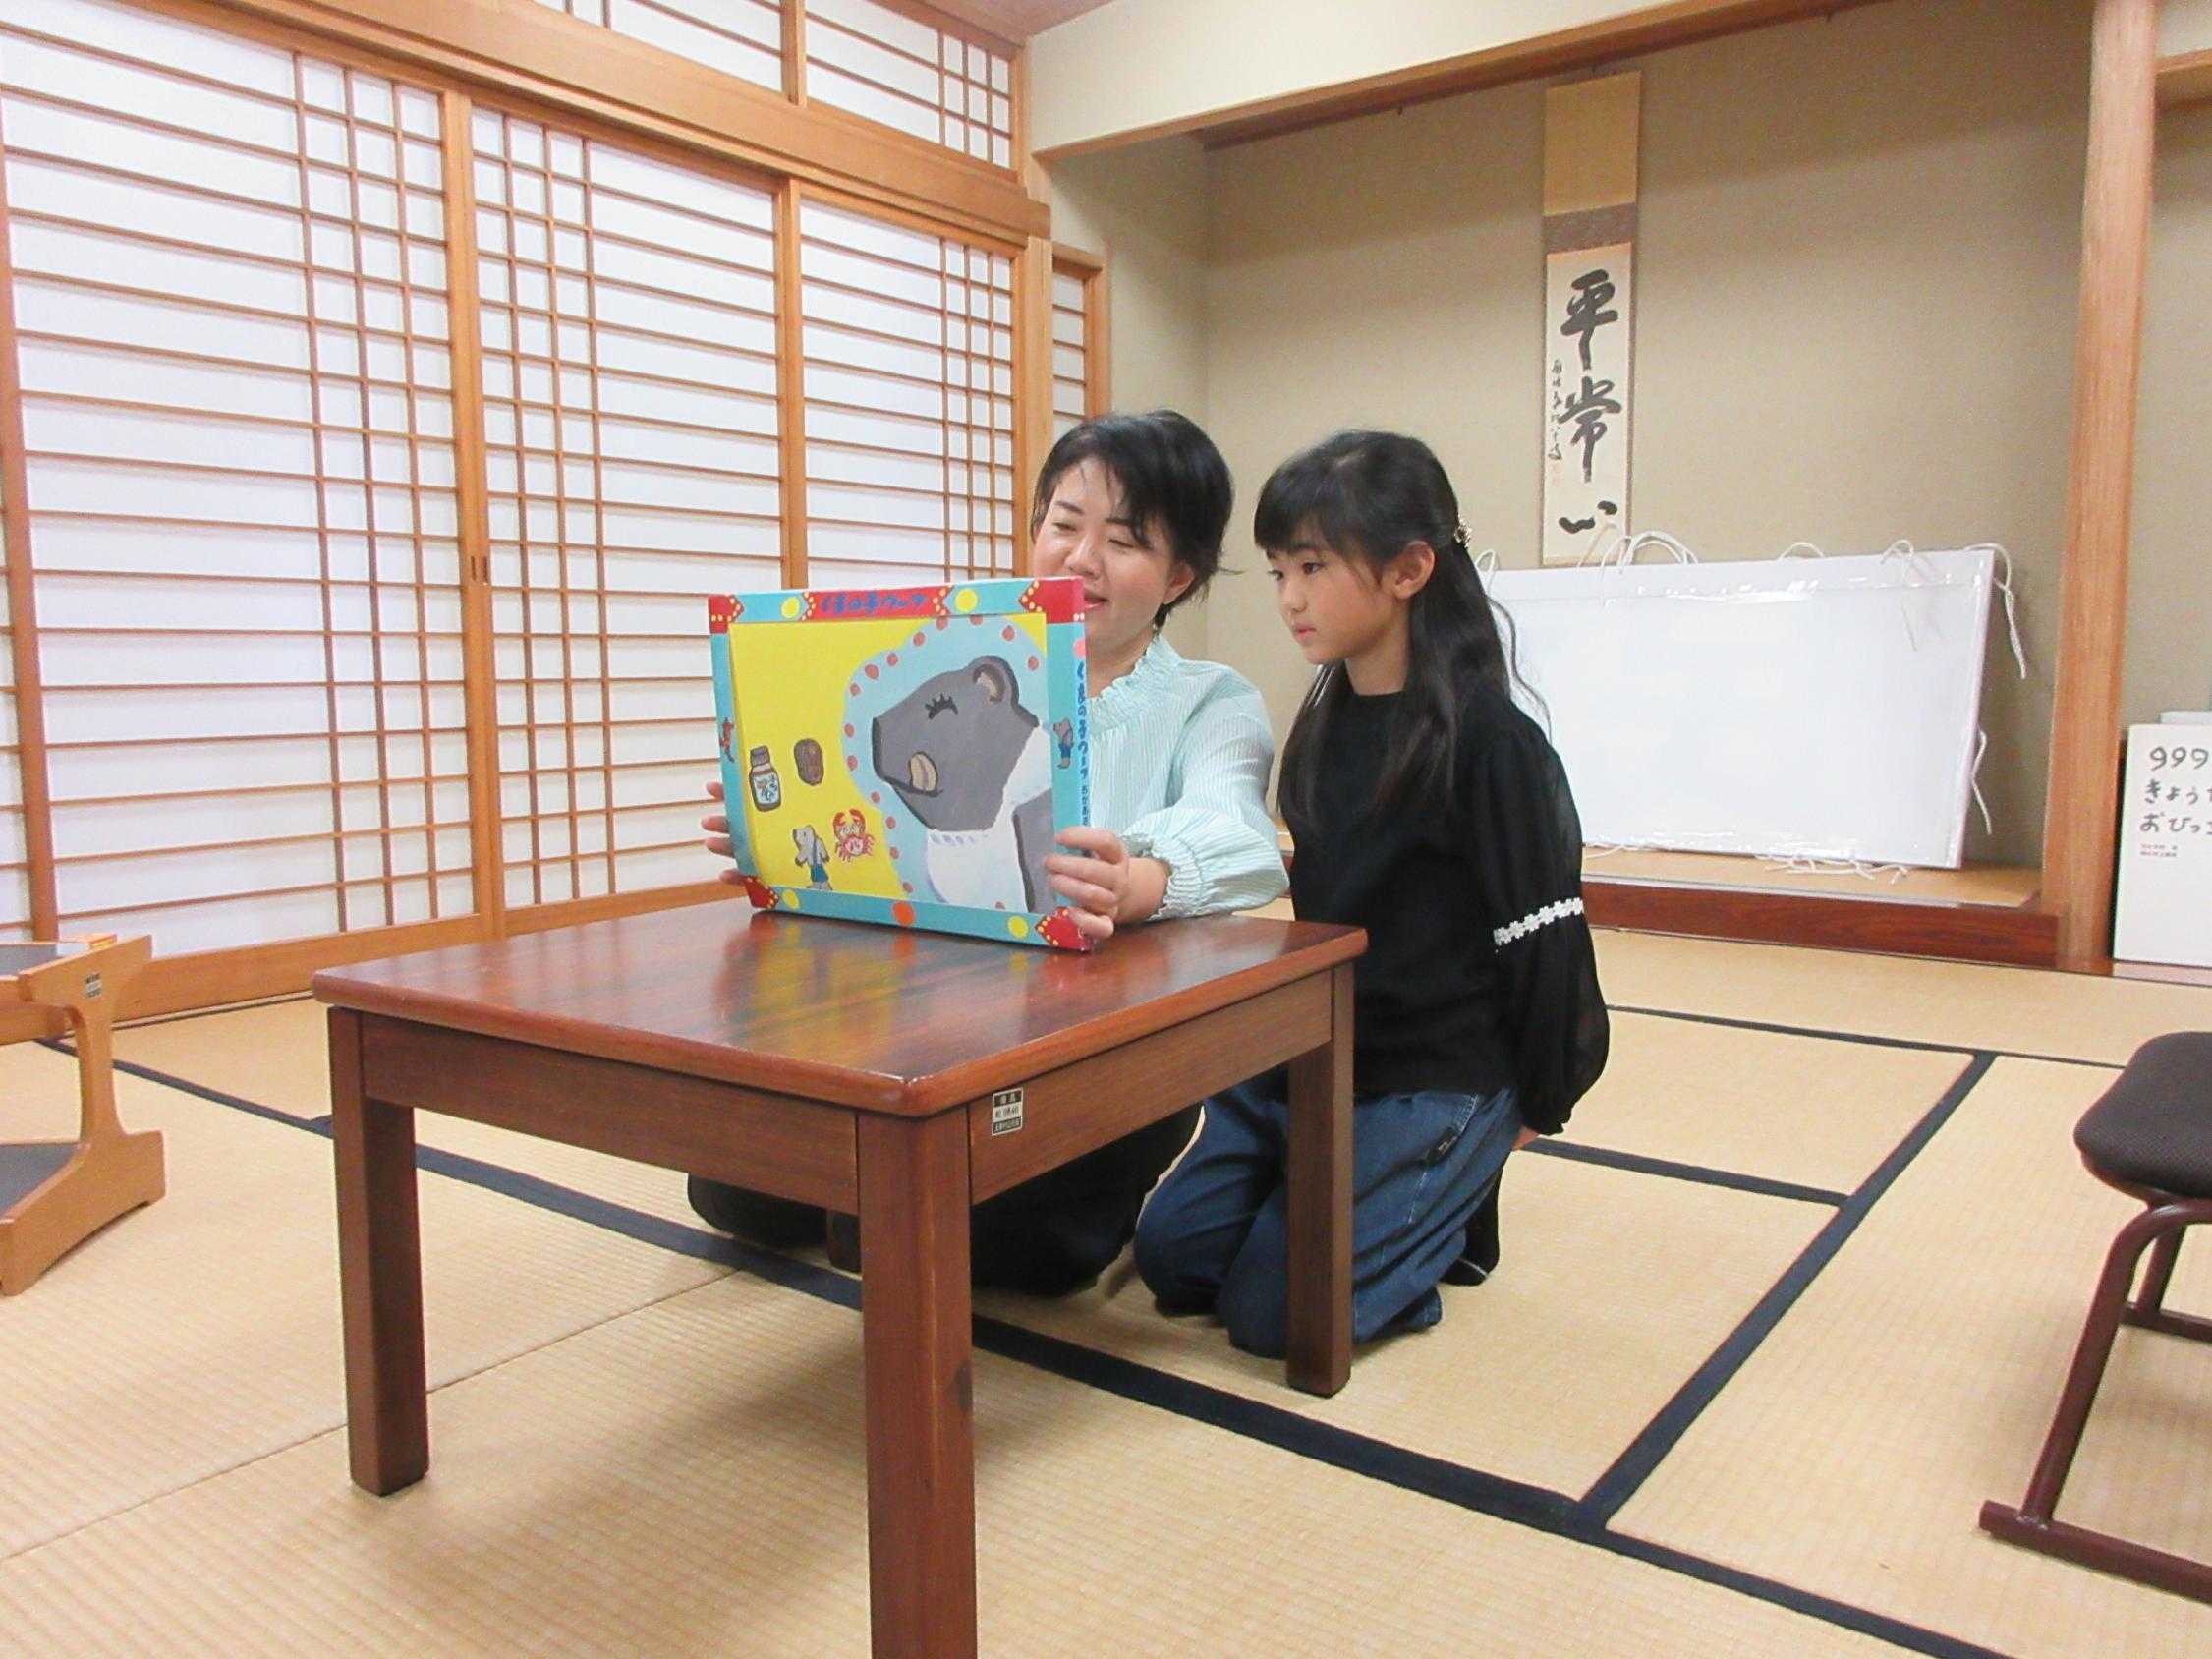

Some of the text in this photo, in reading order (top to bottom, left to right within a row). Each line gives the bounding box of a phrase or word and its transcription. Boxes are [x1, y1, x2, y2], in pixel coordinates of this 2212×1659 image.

[1558, 268, 1622, 535] 平常心
[2149, 746, 2210, 772] 999
